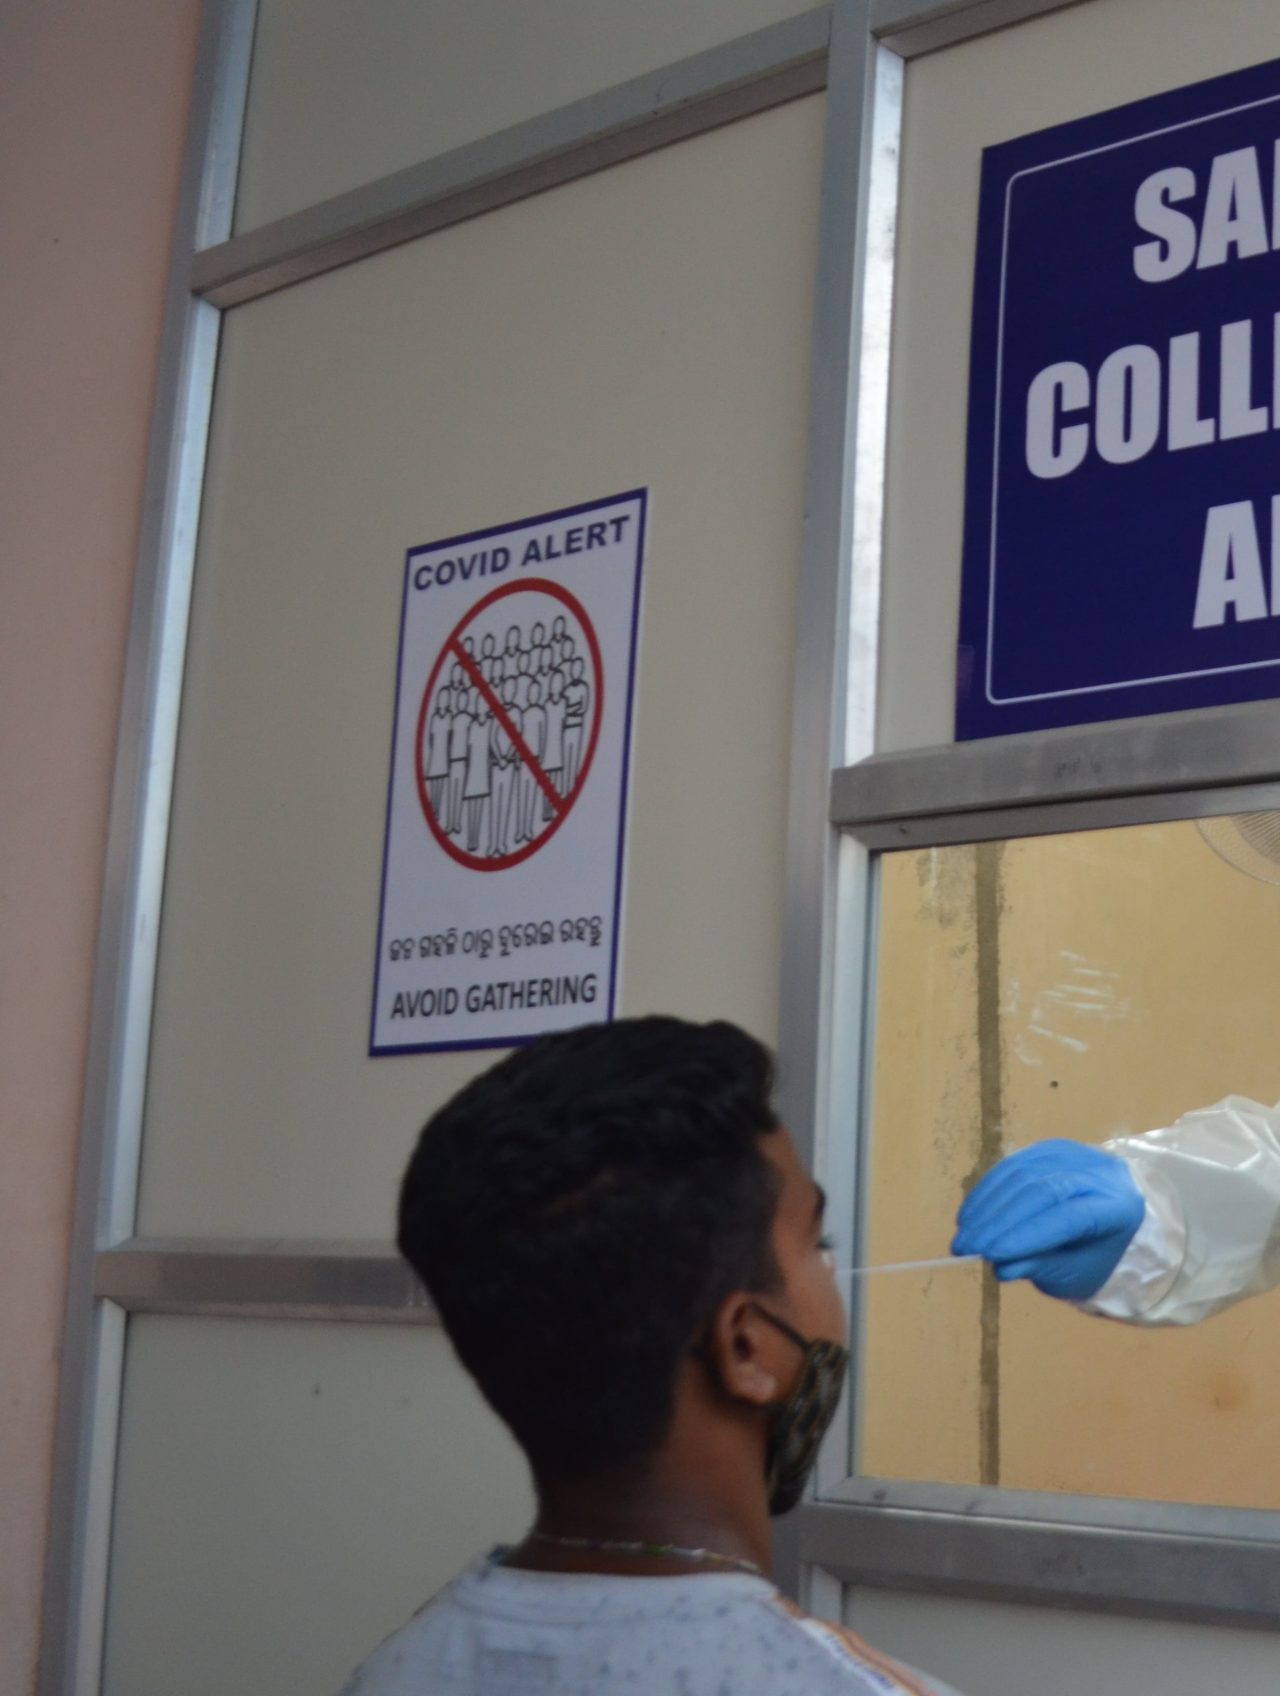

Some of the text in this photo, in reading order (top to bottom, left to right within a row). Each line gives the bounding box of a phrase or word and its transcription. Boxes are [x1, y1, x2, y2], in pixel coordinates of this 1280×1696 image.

[413, 515, 630, 590] COVID ALERT
[390, 973, 597, 1020] AVOID GATHERING
